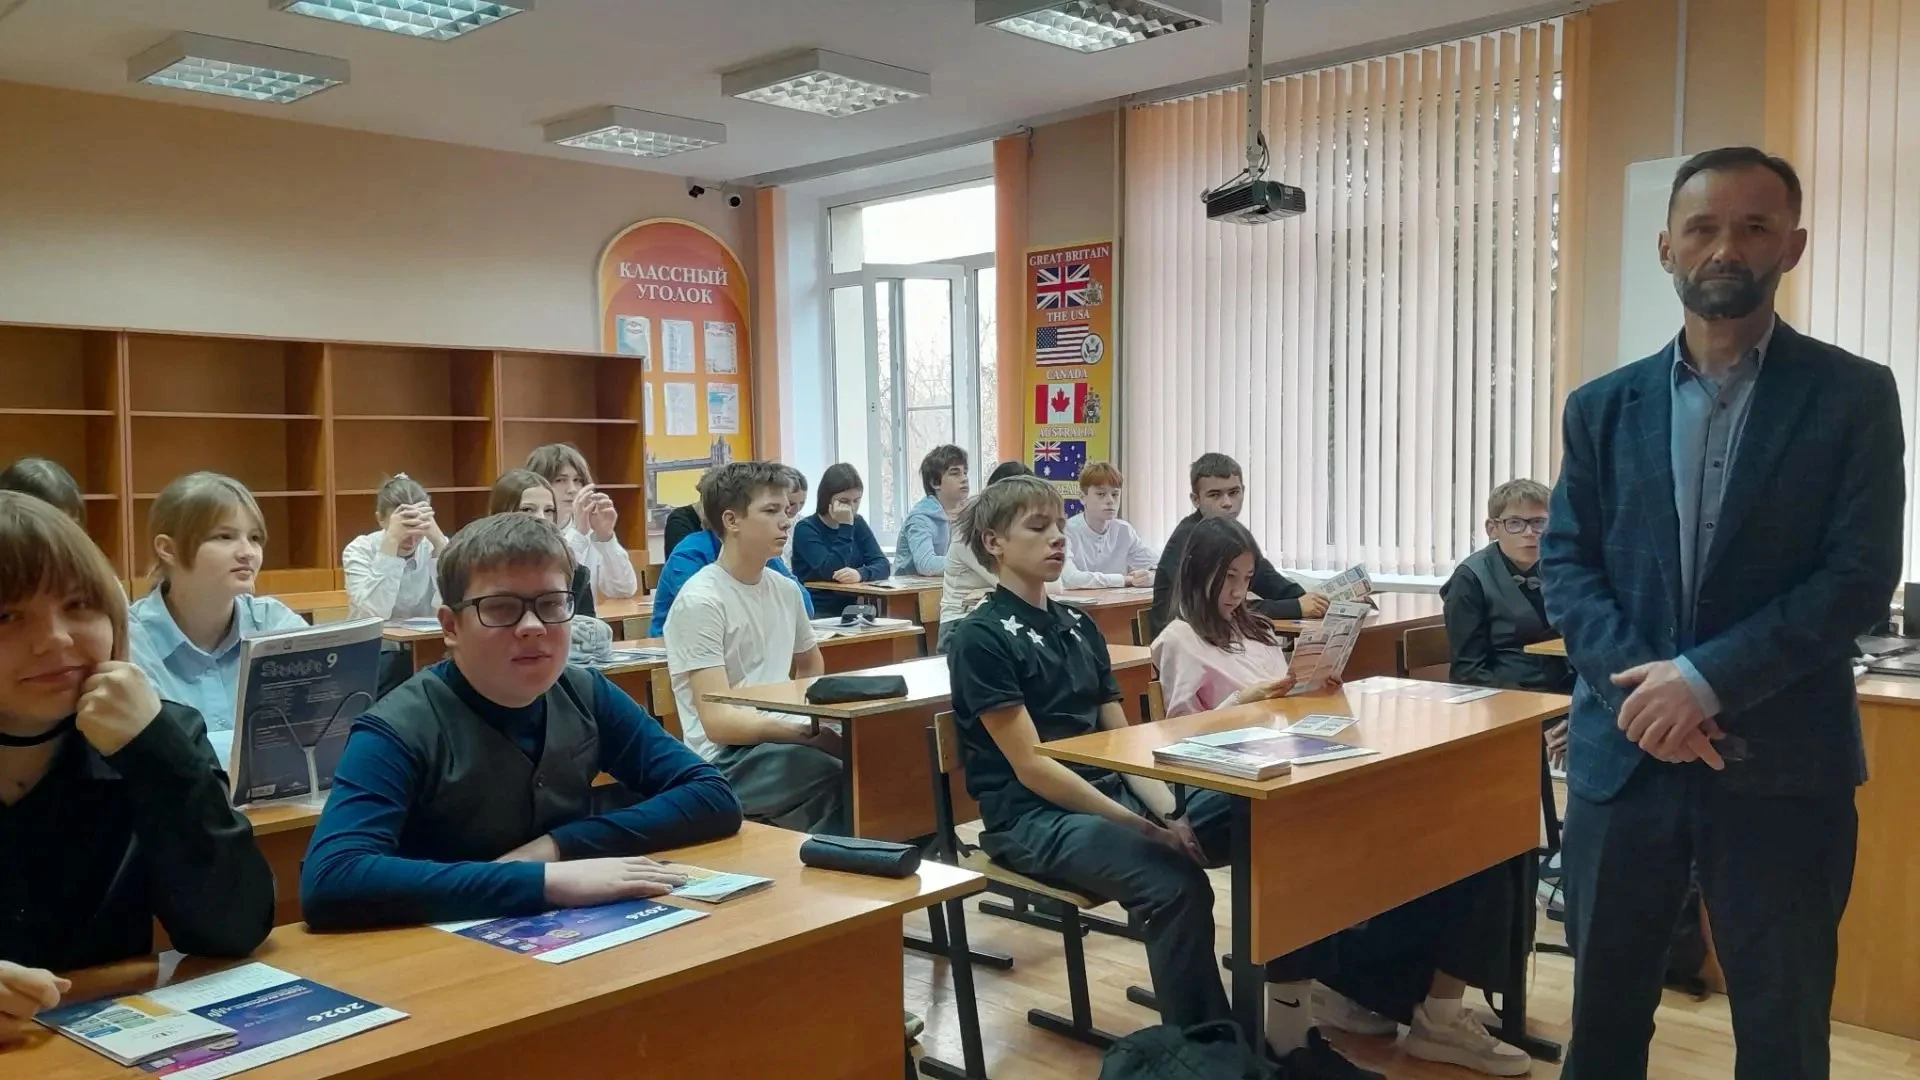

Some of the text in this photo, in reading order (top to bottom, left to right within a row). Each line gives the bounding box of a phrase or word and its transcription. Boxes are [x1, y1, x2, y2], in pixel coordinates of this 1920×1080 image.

[1029, 246, 1110, 266] GREAT BRITAIN
[620, 260, 729, 286] КЛАССНЫЙ
[636, 283, 713, 304] УГОЛОК
[1046, 309, 1090, 322] THE USA
[1046, 368, 1089, 380] CANADA
[1039, 425, 1096, 438] AUSTRALIA
[326, 652, 338, 669] 9
[625, 905, 668, 921] 2026
[306, 1002, 365, 1023] 2026
